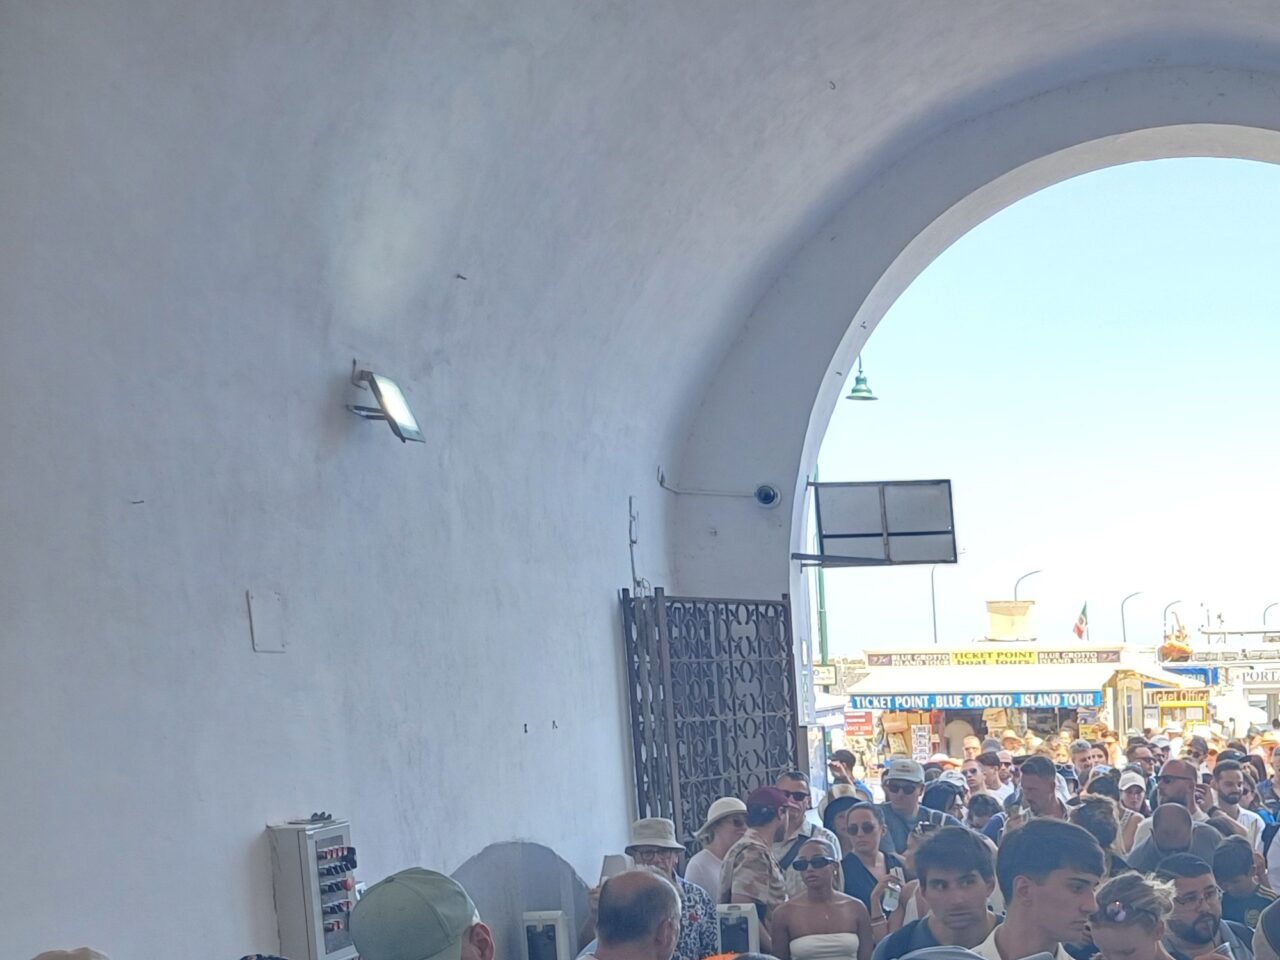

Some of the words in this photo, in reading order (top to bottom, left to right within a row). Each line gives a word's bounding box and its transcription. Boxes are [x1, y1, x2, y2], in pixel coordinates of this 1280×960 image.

[997, 651, 1034, 659] POINT
[1061, 651, 1098, 659] GROTTO
[854, 695, 892, 708] TICKET
[936, 695, 963, 707] BLUE
[1021, 694, 1060, 706] ISLAND
[1063, 693, 1094, 706] TOUR
[1148, 690, 1177, 704] Ticket
[1180, 690, 1209, 701] Office
